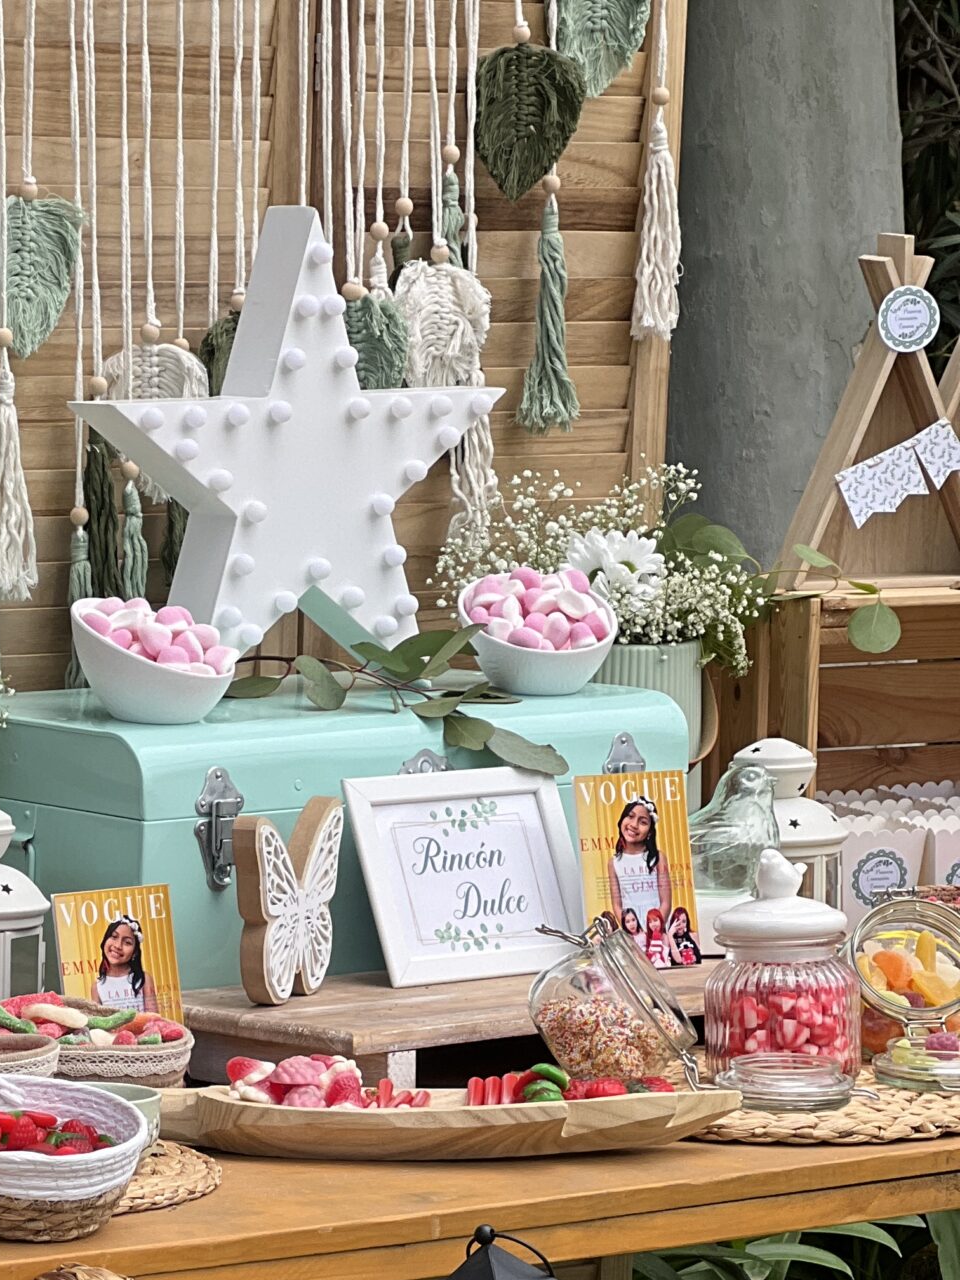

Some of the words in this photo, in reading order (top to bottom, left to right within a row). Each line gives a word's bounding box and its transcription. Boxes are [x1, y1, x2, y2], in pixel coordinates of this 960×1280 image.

[578, 775, 680, 806] VOGUE
[412, 837, 505, 875] Rincón
[59, 893, 166, 928] VOGUE
[453, 878, 528, 920] Dulce
